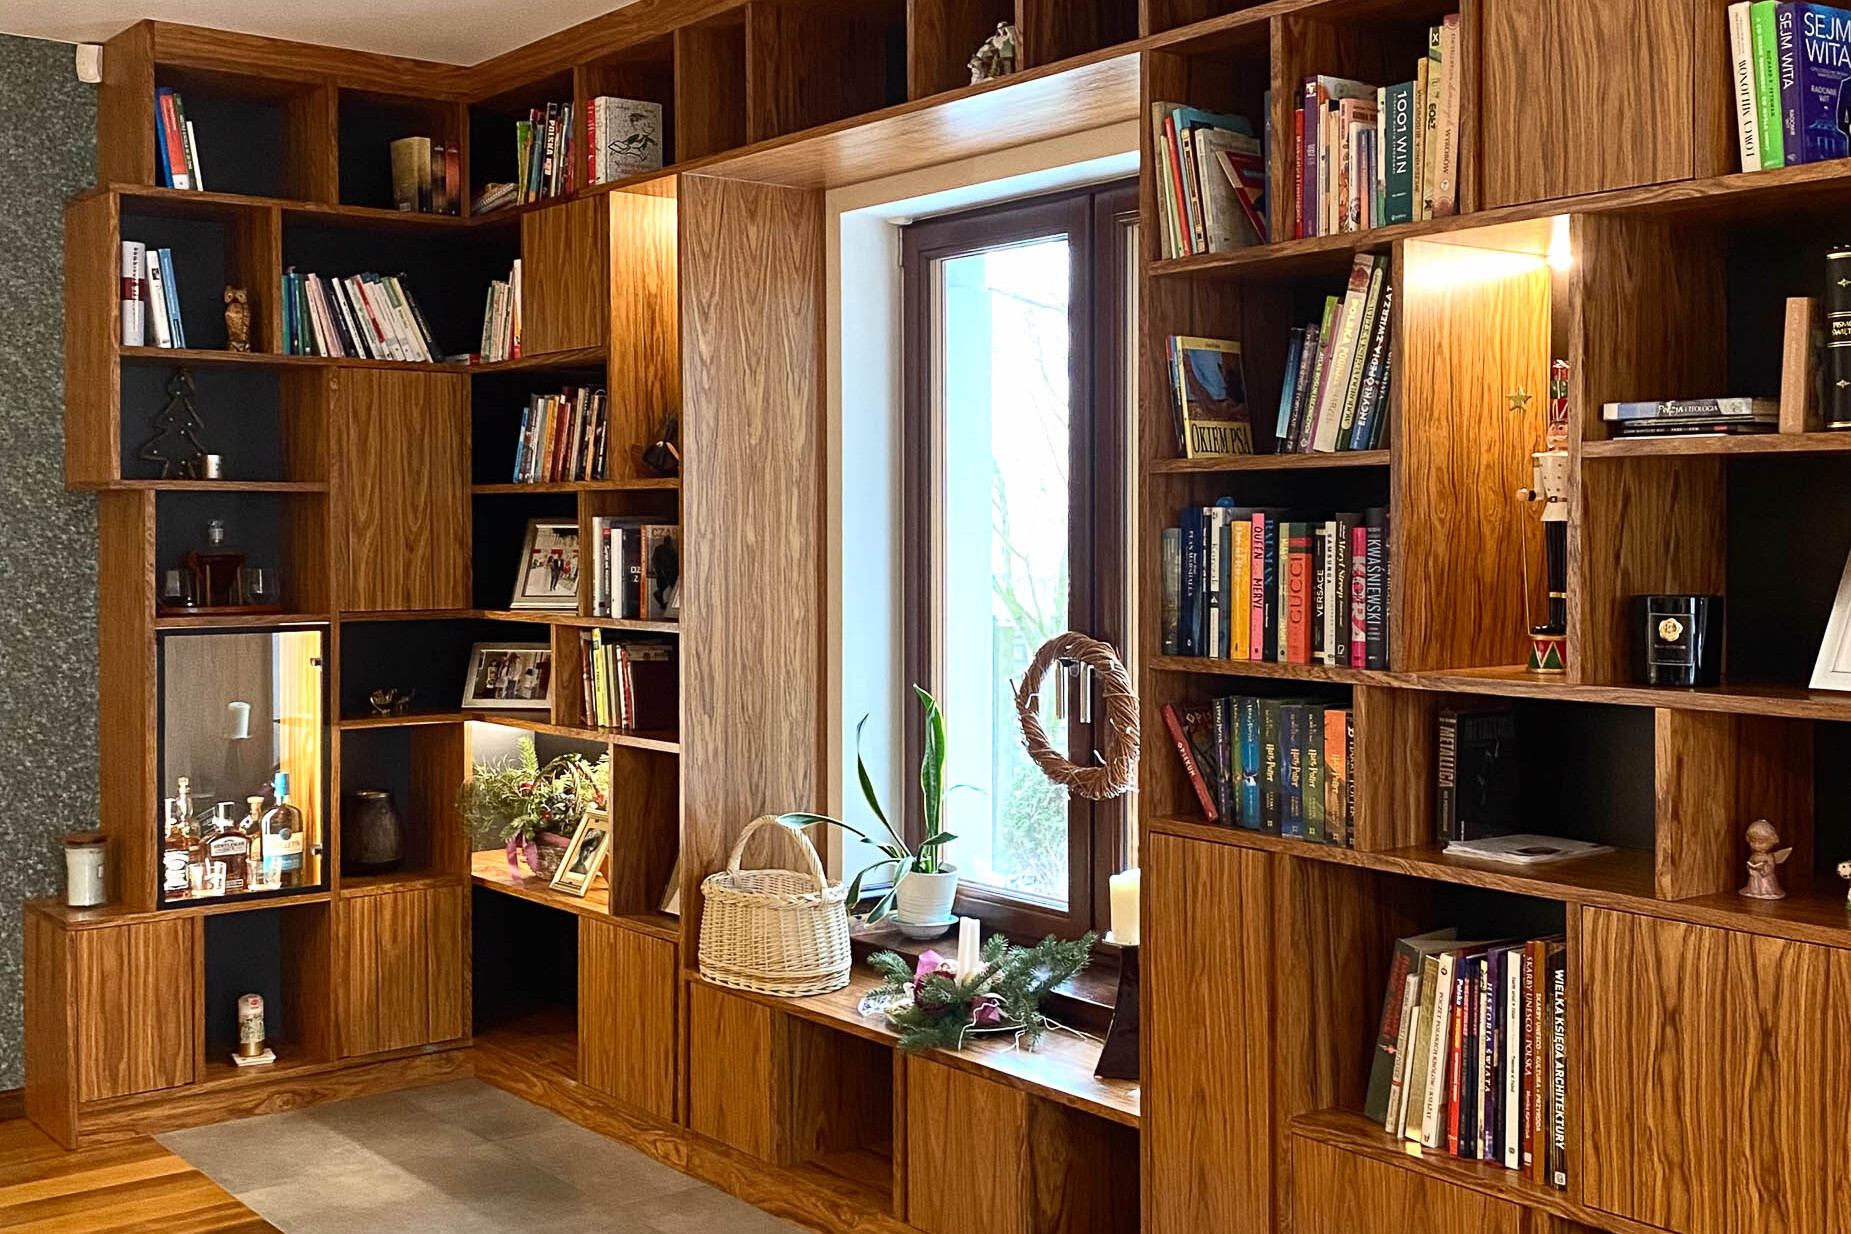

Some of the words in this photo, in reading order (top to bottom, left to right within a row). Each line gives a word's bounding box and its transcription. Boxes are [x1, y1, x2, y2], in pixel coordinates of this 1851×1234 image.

[1779, 12, 1793, 50] SEJM
[1804, 11, 1851, 41] SEJM
[1781, 52, 1795, 90] WITA
[1805, 38, 1851, 68] WITA
[1396, 90, 1407, 133] 1001
[546, 119, 556, 156] POLSKA
[1396, 135, 1407, 174] WIN
[1342, 298, 1359, 345] POLSKA
[1191, 423, 1229, 454] OKIEM
[1229, 424, 1251, 454] PSA
[1253, 526, 1263, 560] QUEEN
[1338, 539, 1346, 568] Meryl
[1289, 557, 1303, 624] GUCCI
[1316, 569, 1324, 617] VERSACE
[1337, 569, 1346, 599] Streep
[1352, 556, 1366, 643] KORA
[1367, 539, 1385, 625] KWAŚNIEWSKI
[1177, 742, 1195, 776] OPIEKUN
[1266, 743, 1275, 760] Harry
[1290, 748, 1300, 766] Harry
[1308, 748, 1317, 766] Harry
[1439, 725, 1455, 788] METALLICA
[1266, 761, 1276, 782] Potter
[1291, 766, 1301, 788] Potter
[1308, 767, 1318, 788] Potter
[1525, 956, 1533, 992] SKARBY
[1554, 969, 1565, 1015] WIELKA
[1485, 982, 1493, 1042] HISTORIA
[1525, 993, 1533, 1033] UNESCO
[1552, 1016, 1565, 1059] KSIĘGA
[1485, 1048, 1493, 1093] ŚWIATA
[1524, 1039, 1533, 1076] POLSKA
[1555, 1060, 1565, 1150] ARCHITEKTURY
